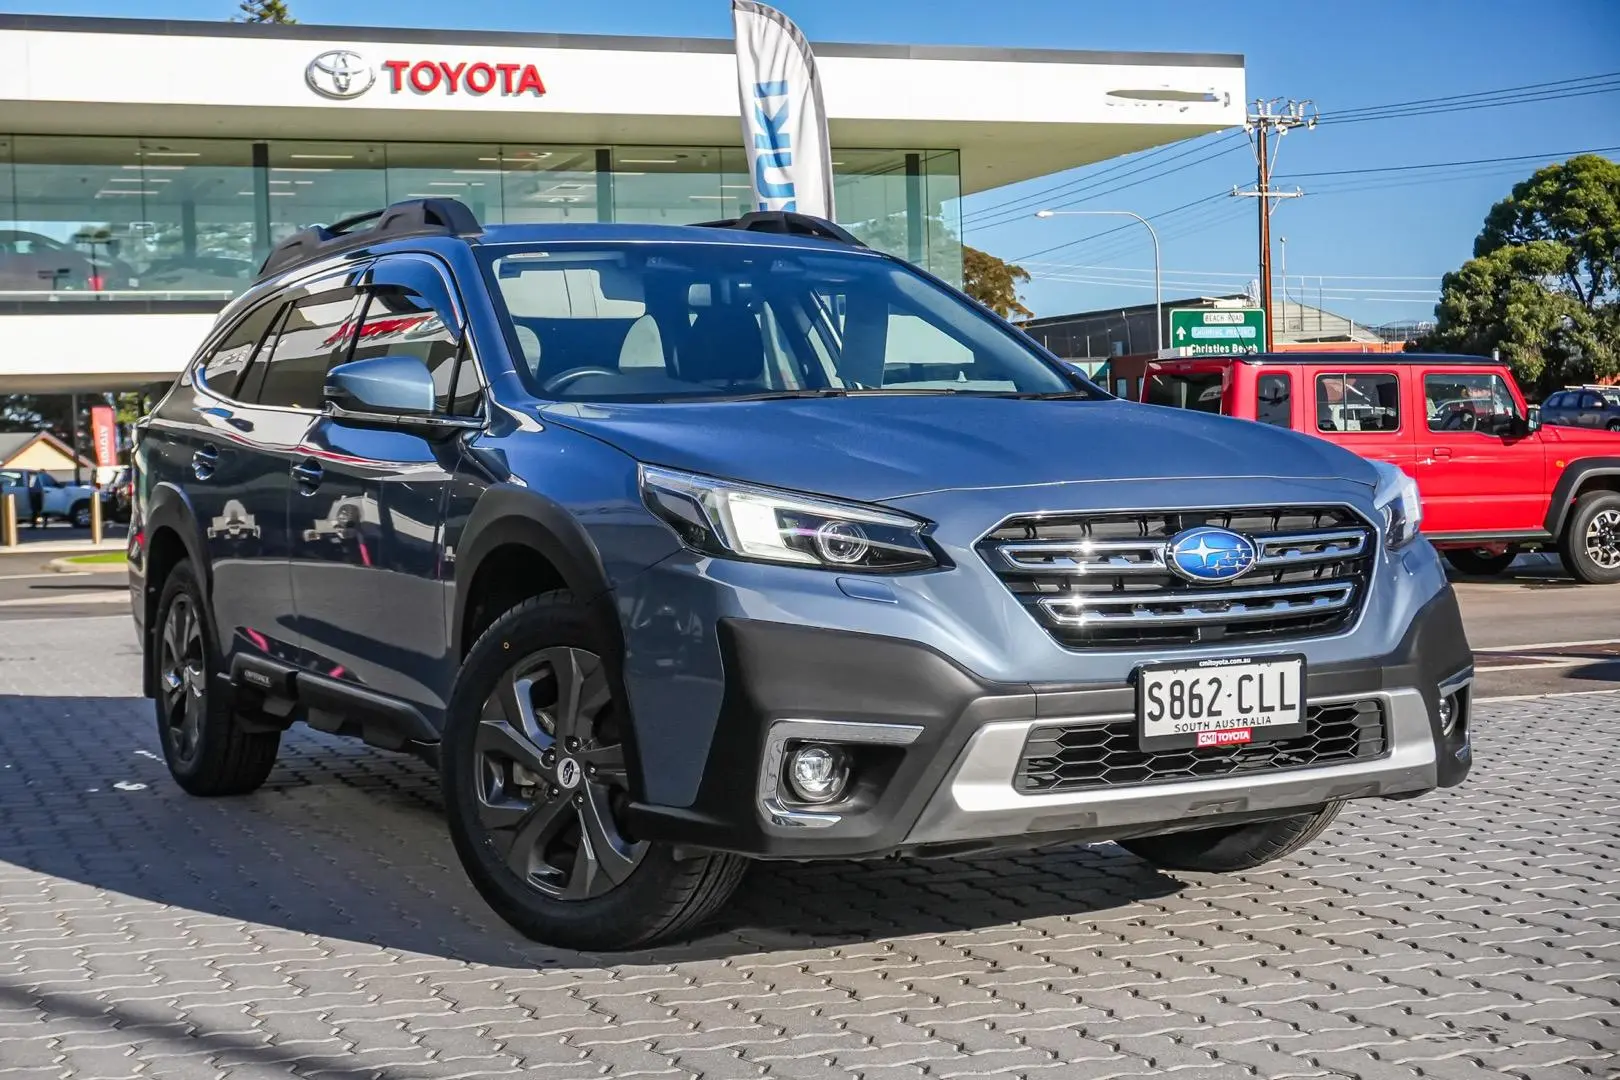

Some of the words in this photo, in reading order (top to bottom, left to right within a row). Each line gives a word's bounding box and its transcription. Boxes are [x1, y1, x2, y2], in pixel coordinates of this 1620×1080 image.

[385, 60, 546, 95] TOYOTA
[1190, 343, 1229, 354] Christies
[1174, 720, 1210, 733] SOUTH
[1214, 715, 1272, 729] AUSTRALIA
[1199, 733, 1216, 744] CMI
[1217, 730, 1250, 742] TOYOTA
